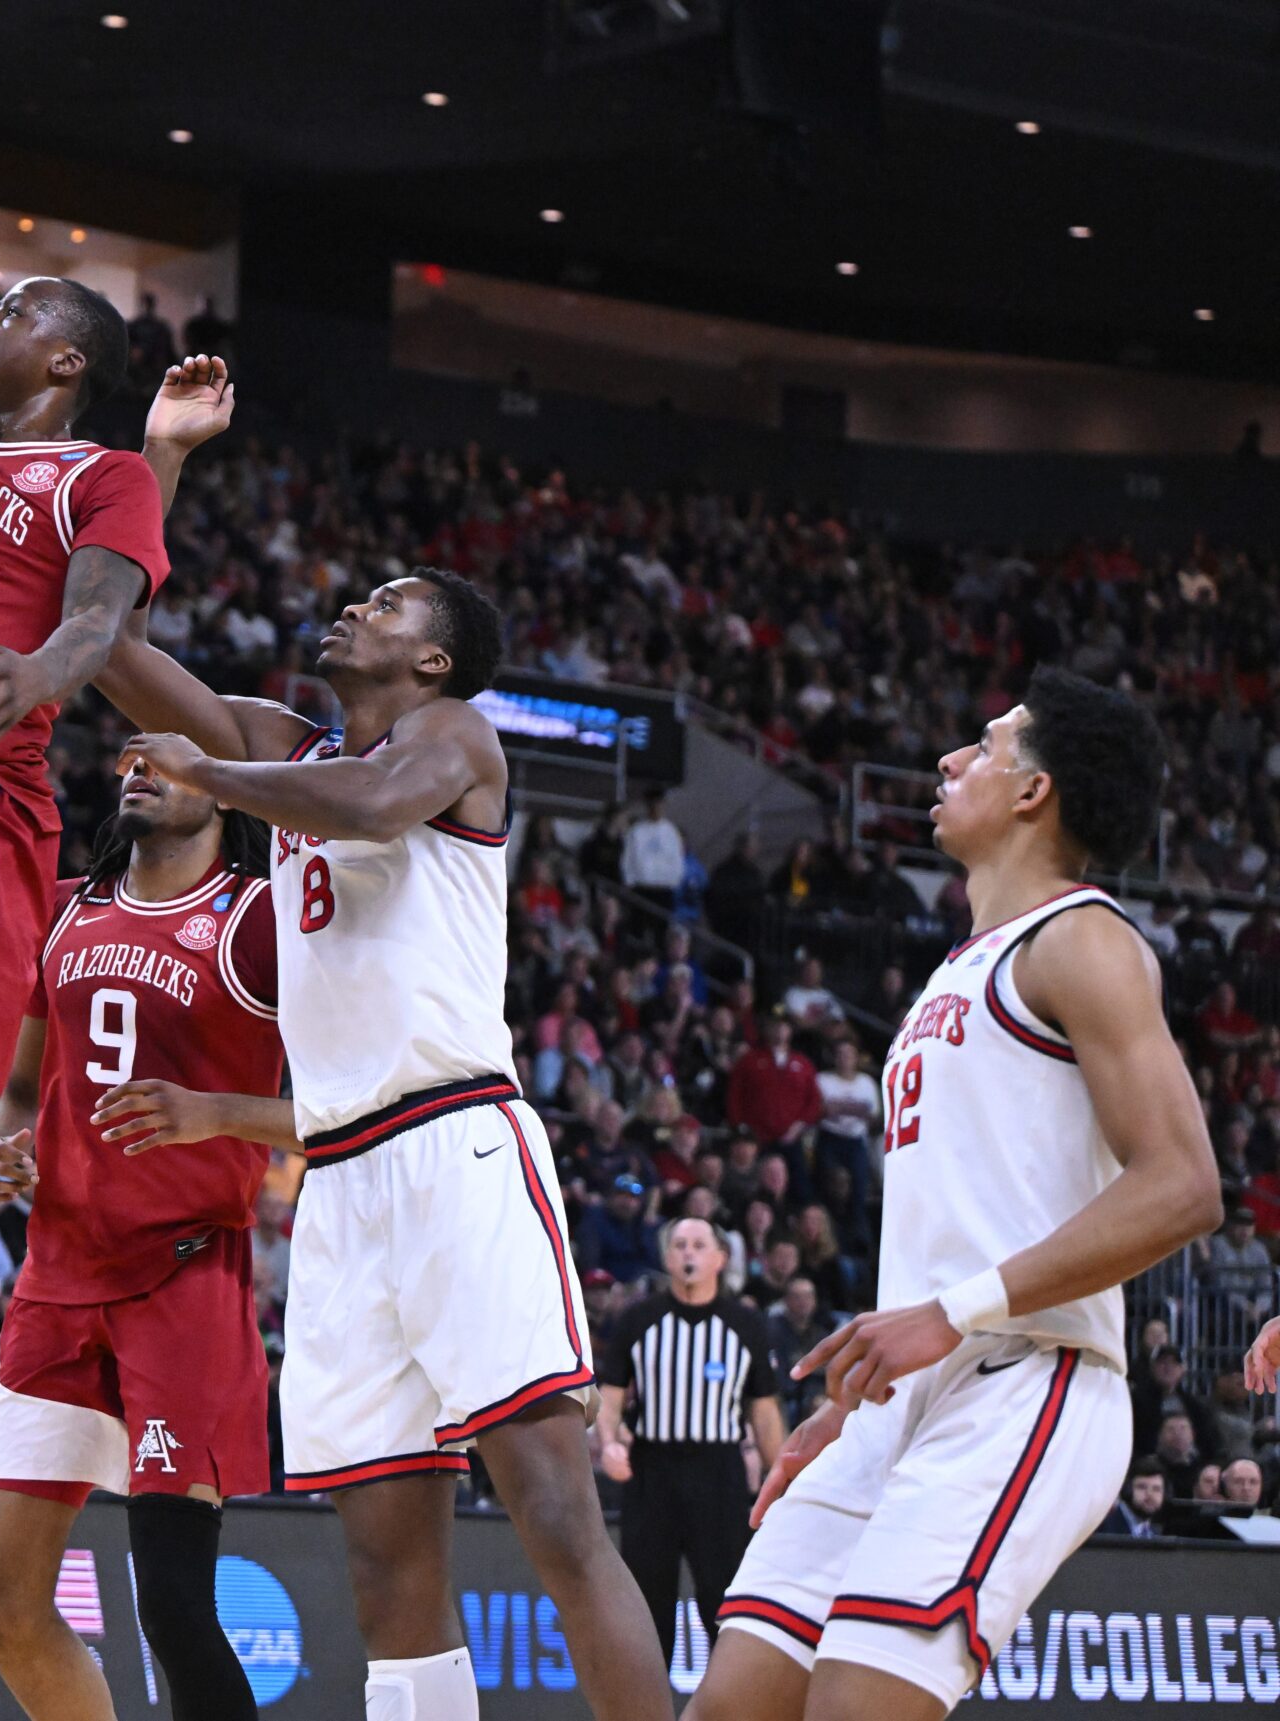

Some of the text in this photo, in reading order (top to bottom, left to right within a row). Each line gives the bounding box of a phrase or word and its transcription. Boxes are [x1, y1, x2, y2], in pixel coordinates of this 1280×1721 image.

[25, 463, 56, 484] SEC
[186, 917, 214, 940] SEC
[299, 854, 335, 934] 8
[56, 943, 198, 1007] RAZORBACKS
[85, 988, 138, 1084] 9
[883, 1053, 923, 1155] 12
[223, 1628, 300, 1666] CAA
[461, 1590, 578, 1691] VIS
